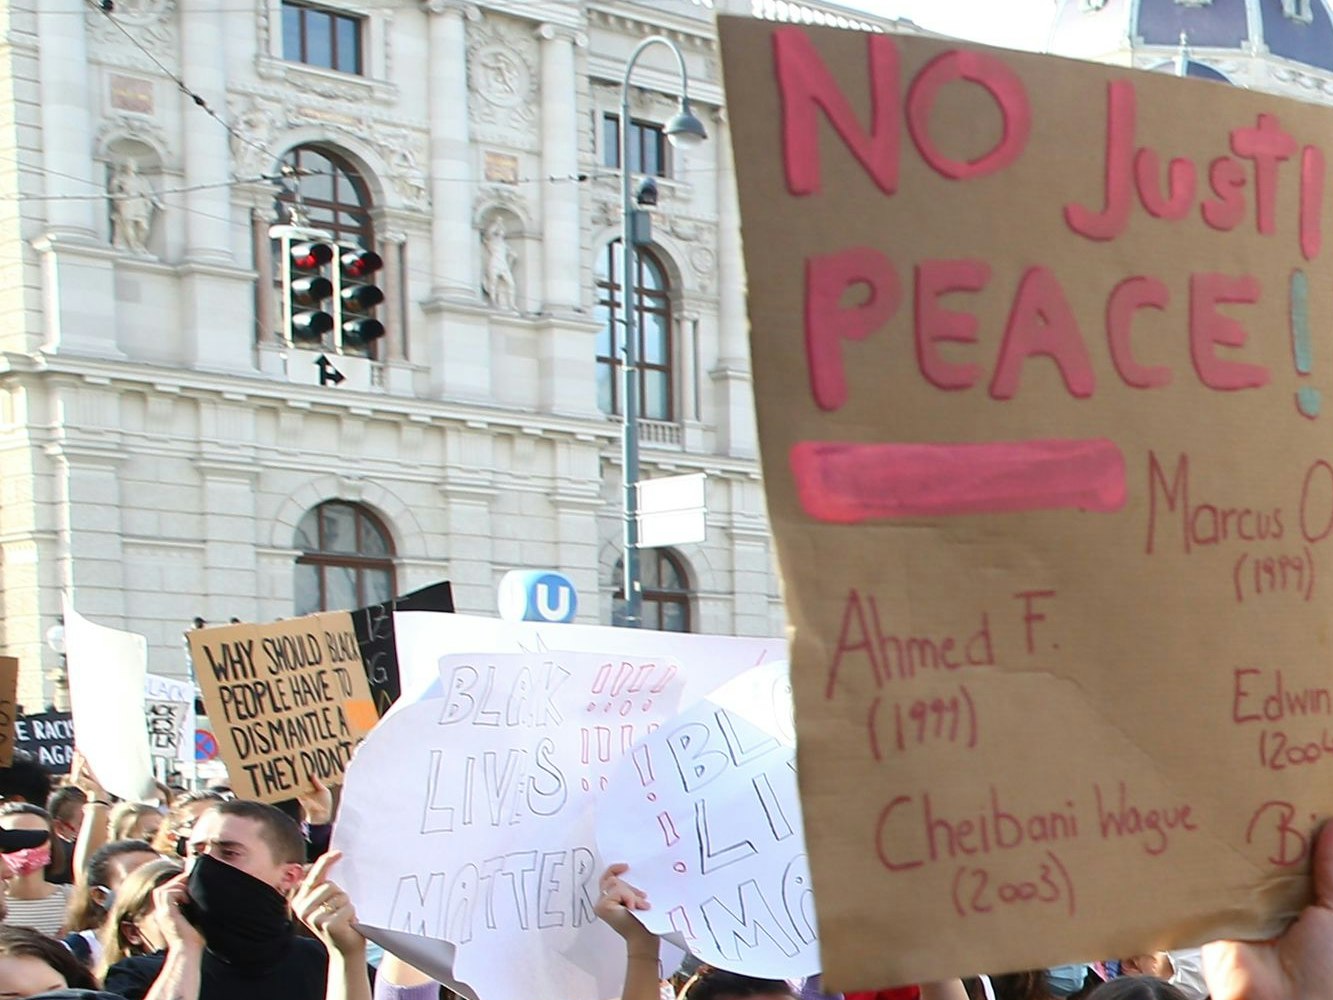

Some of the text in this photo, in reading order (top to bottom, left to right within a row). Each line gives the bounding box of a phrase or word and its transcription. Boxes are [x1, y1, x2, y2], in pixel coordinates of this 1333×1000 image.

[771, 25, 1035, 198] NO
[805, 246, 1323, 419] PEACE!
[1146, 450, 1287, 555] Marcus
[536, 583, 570, 621] U
[203, 630, 361, 682] WHY SHOULD BLACK
[825, 589, 1061, 700] Ahmed F.
[219, 667, 354, 724] PEOPLE HAVE TO
[1232, 665, 1332, 725] Edwin
[230, 705, 350, 760] DISMANTLE A
[242, 754, 302, 798] THEY
[874, 788, 1082, 873] Cheibani
[388, 847, 602, 945] MATTER
[951, 857, 1076, 916] (2003)
